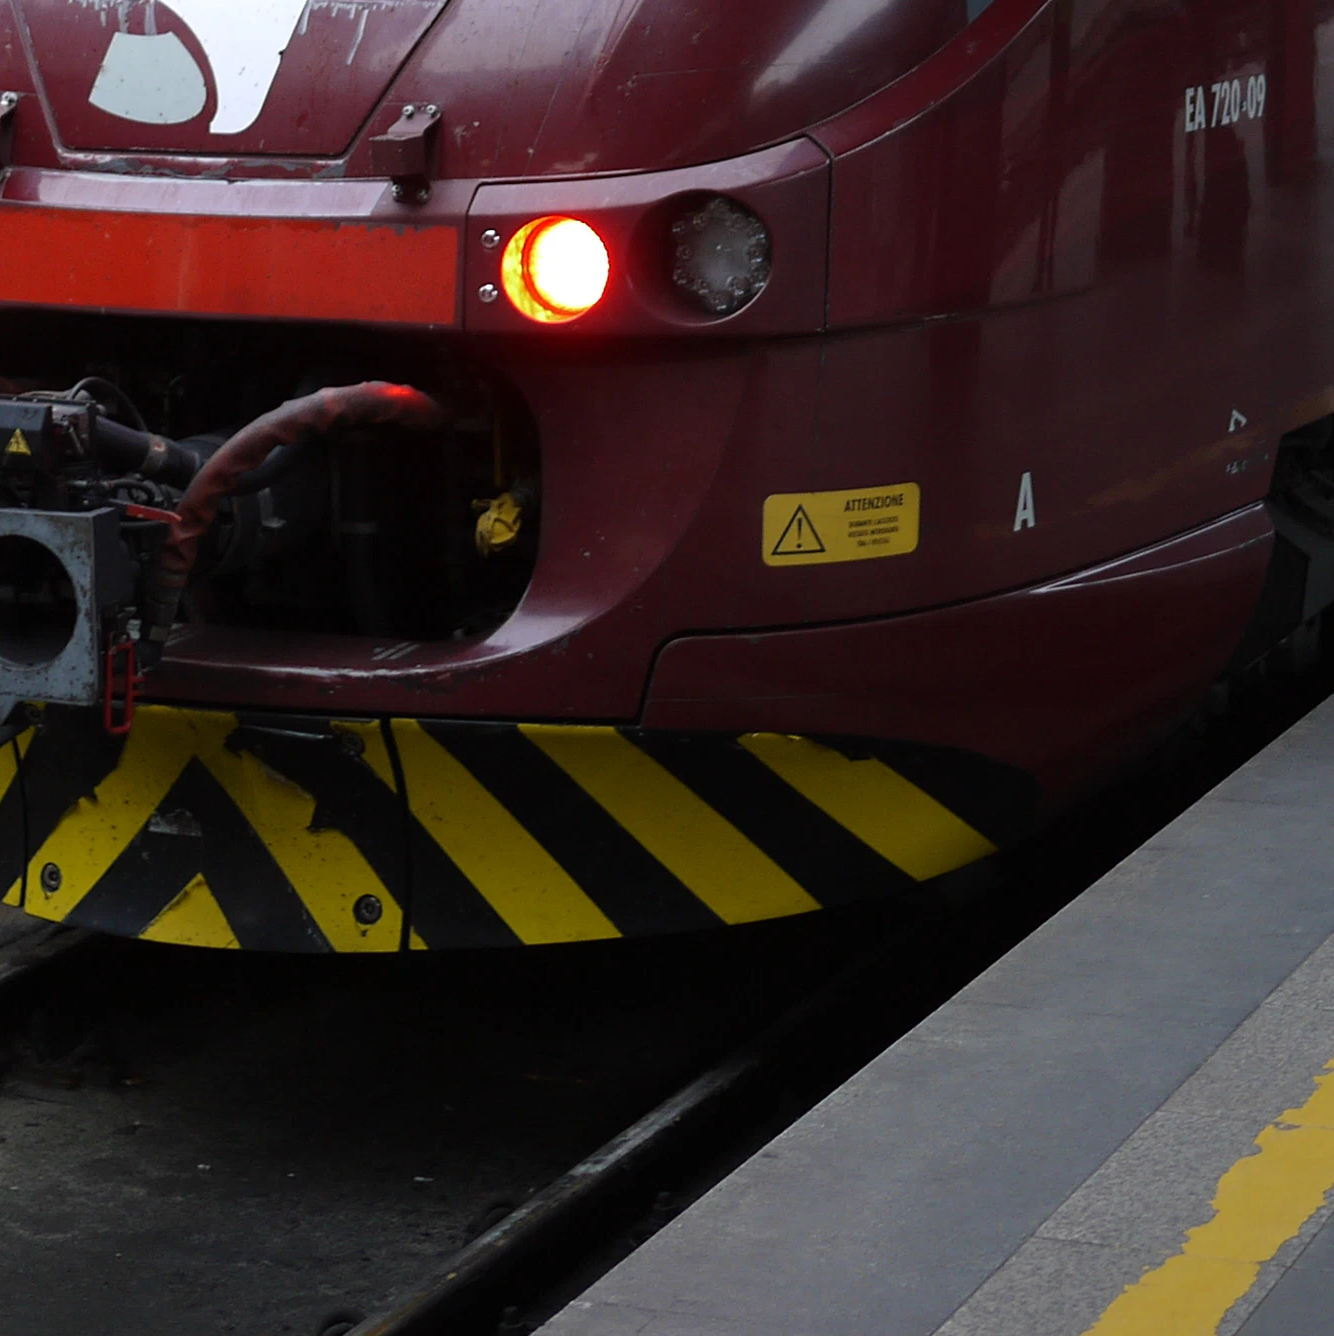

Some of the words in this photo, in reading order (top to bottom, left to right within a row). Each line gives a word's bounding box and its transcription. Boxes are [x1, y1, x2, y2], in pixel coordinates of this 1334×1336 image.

[1184, 85, 1206, 132] EA
[1210, 73, 1266, 128] 720-09
[843, 493, 905, 513] ATTENZIONE
[1013, 471, 1036, 532] A
